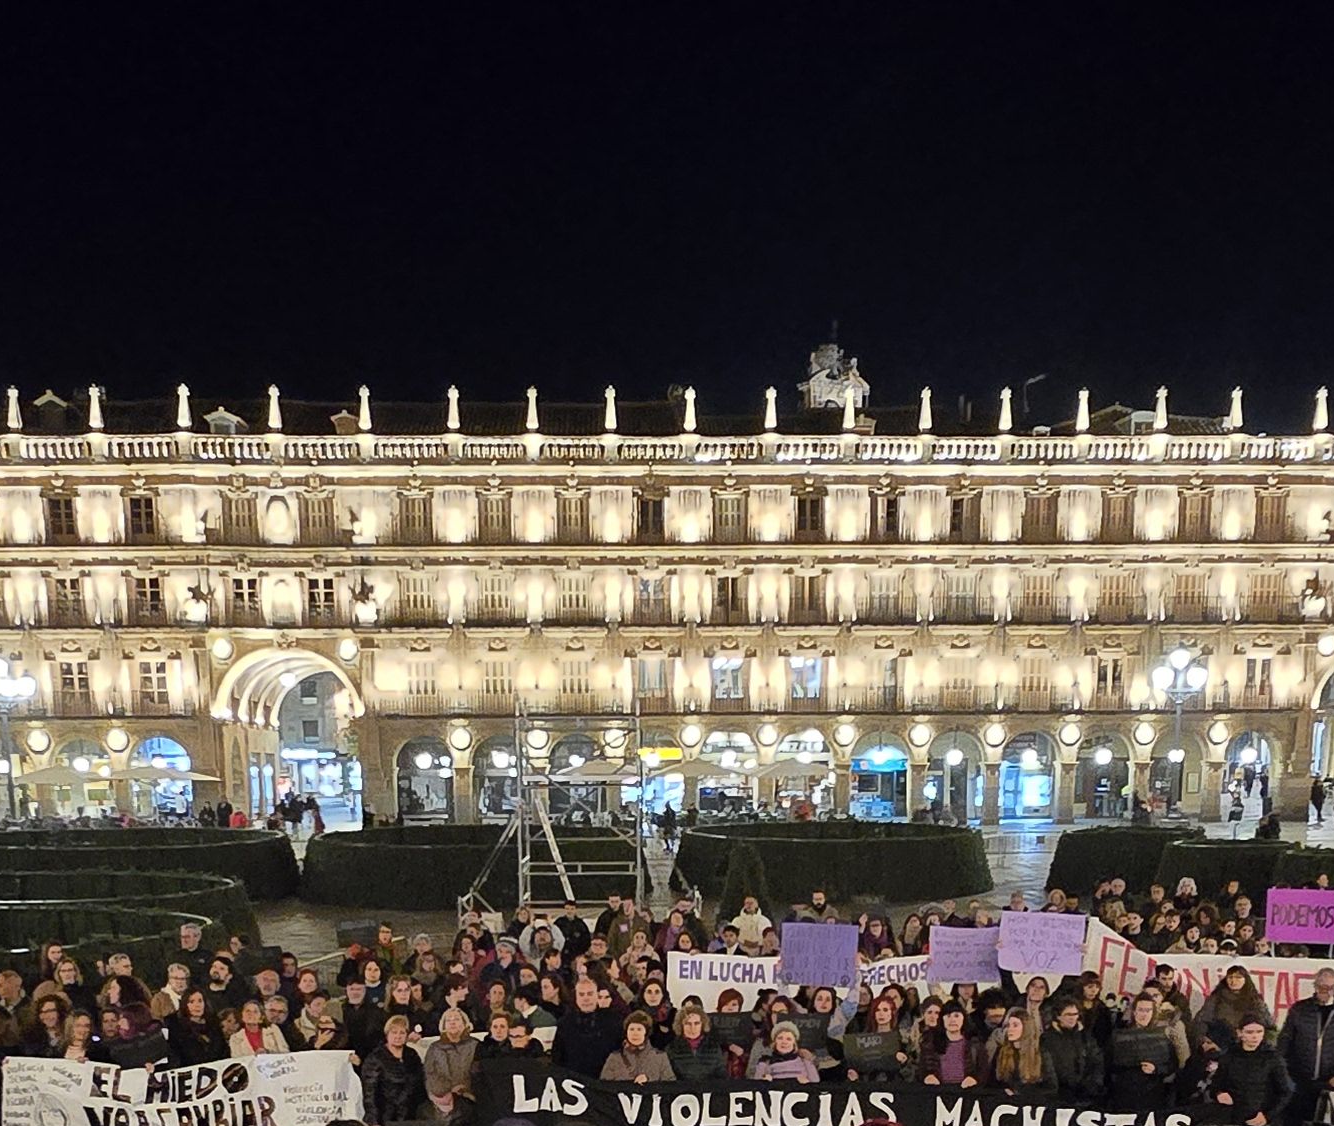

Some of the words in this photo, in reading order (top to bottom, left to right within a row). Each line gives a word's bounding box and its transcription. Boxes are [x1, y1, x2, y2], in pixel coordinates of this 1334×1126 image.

[1270, 906, 1334, 929] PODEMOS
[679, 959, 701, 980] EN
[708, 961, 766, 984] LUCHA
[1020, 950, 1060, 970] VOZ
[89, 1066, 132, 1103] EL
[512, 1073, 589, 1117] LAS
